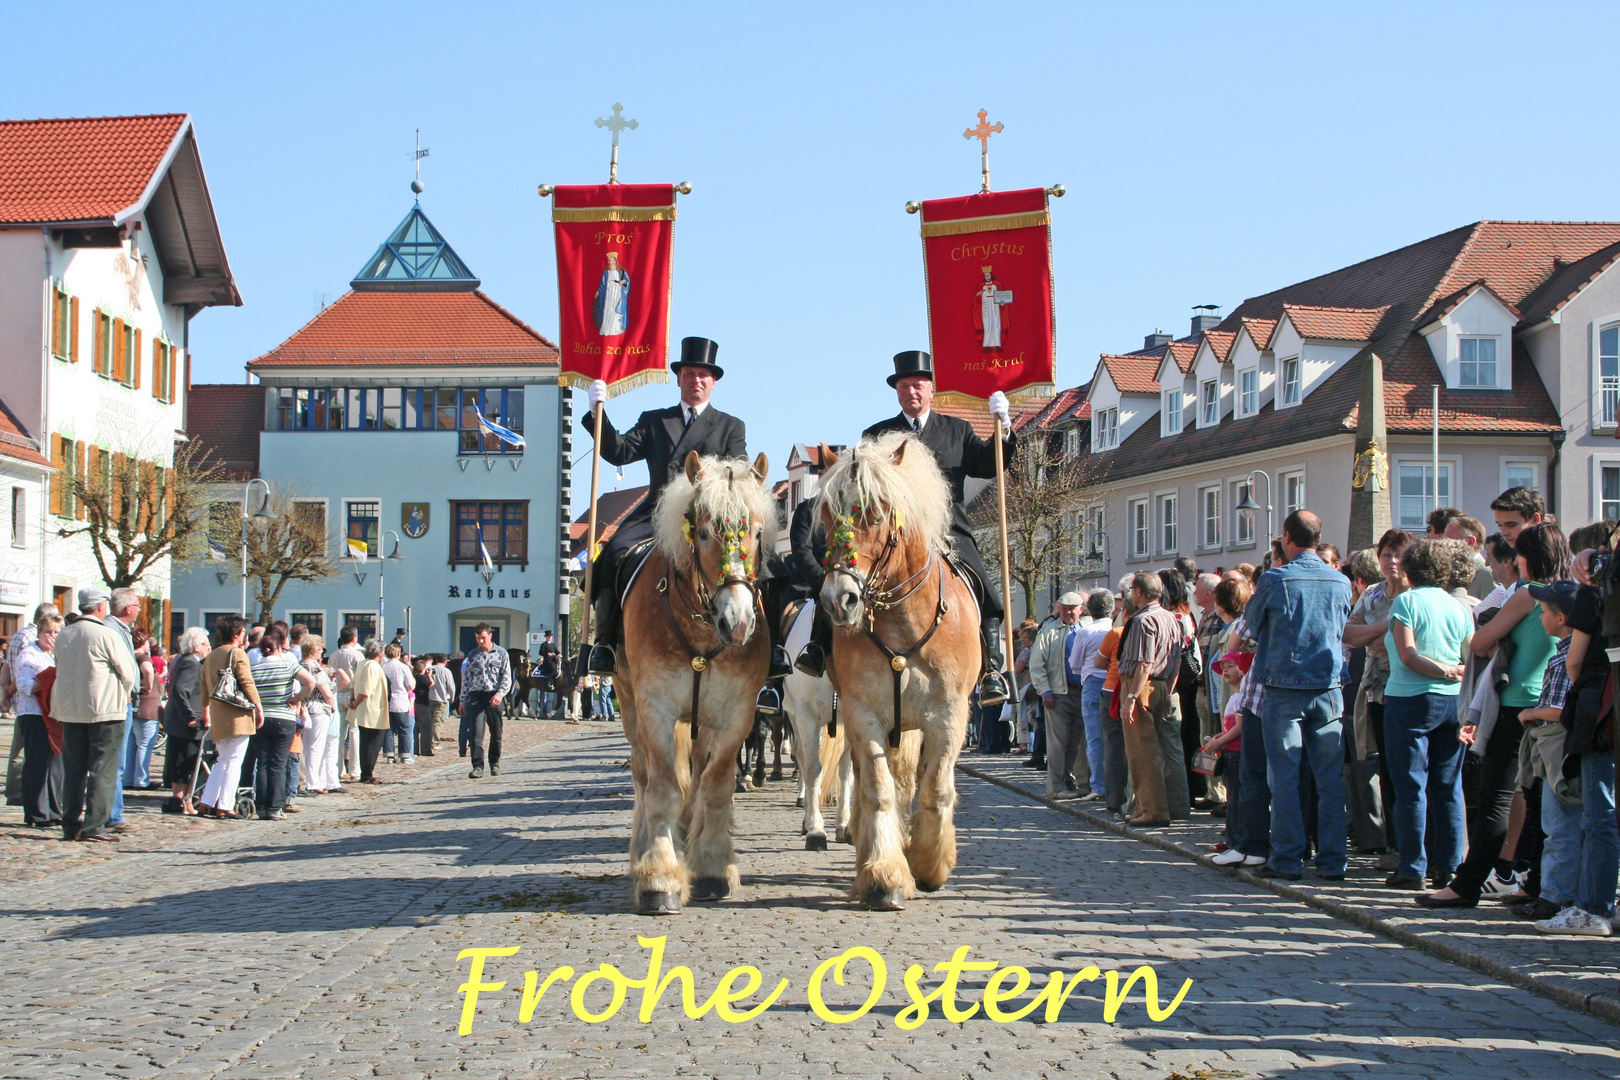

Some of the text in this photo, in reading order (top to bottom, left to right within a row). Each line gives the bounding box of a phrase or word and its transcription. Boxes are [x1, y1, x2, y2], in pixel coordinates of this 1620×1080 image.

[950, 241, 1025, 261] Chrystus
[572, 342, 651, 355] Boha za nas
[963, 351, 1025, 371] naš Kral
[448, 585, 531, 600] Rathaus
